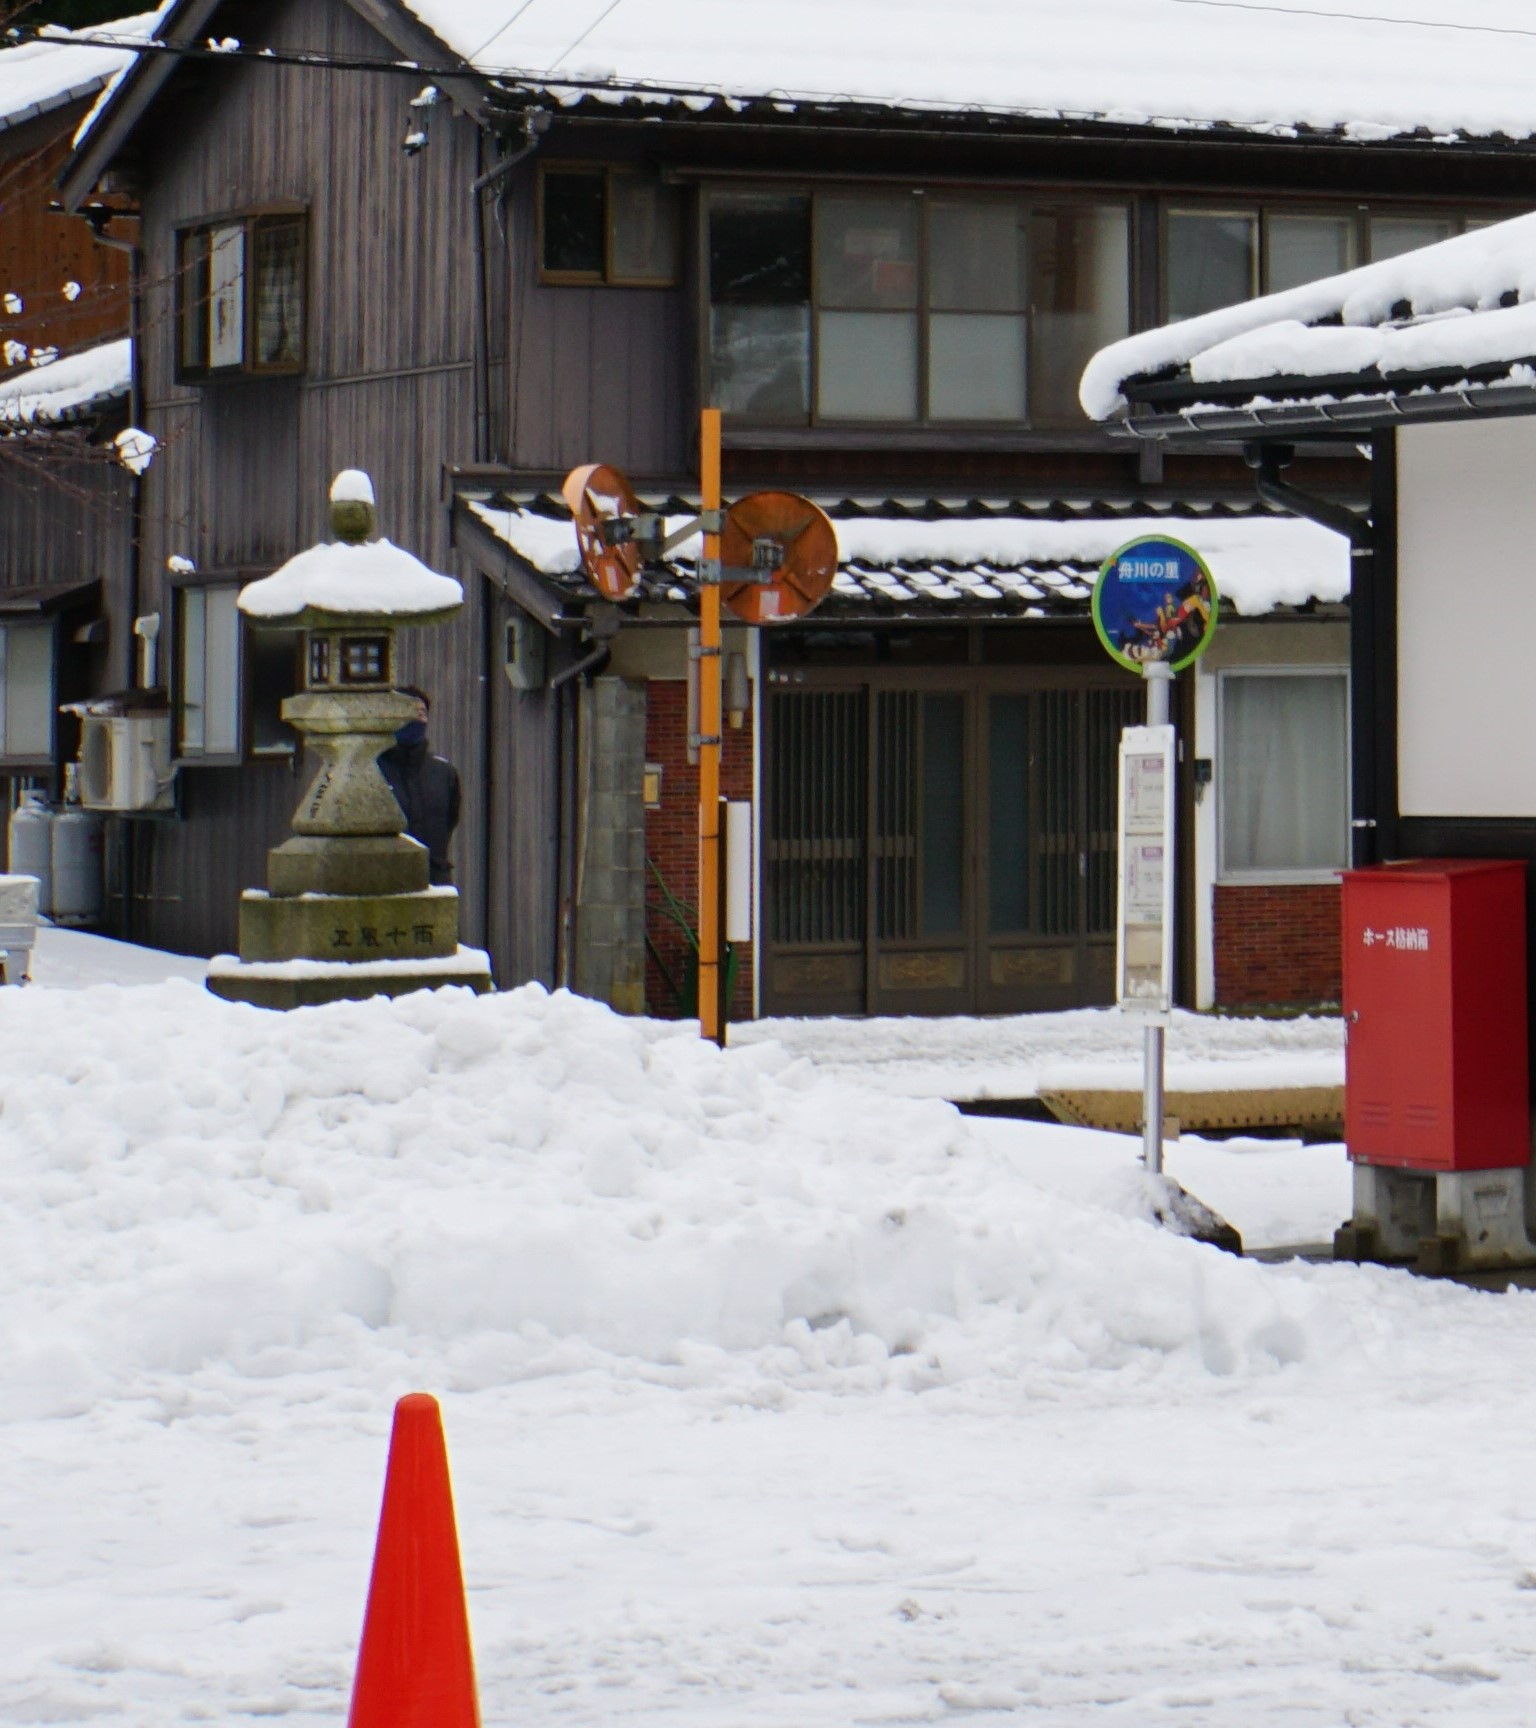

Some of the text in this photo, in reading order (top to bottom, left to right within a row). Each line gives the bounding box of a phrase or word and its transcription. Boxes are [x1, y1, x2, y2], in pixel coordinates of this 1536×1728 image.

[1118, 561, 1180, 580] 舟川の里
[1363, 927, 1429, 951] ホース格納箱
